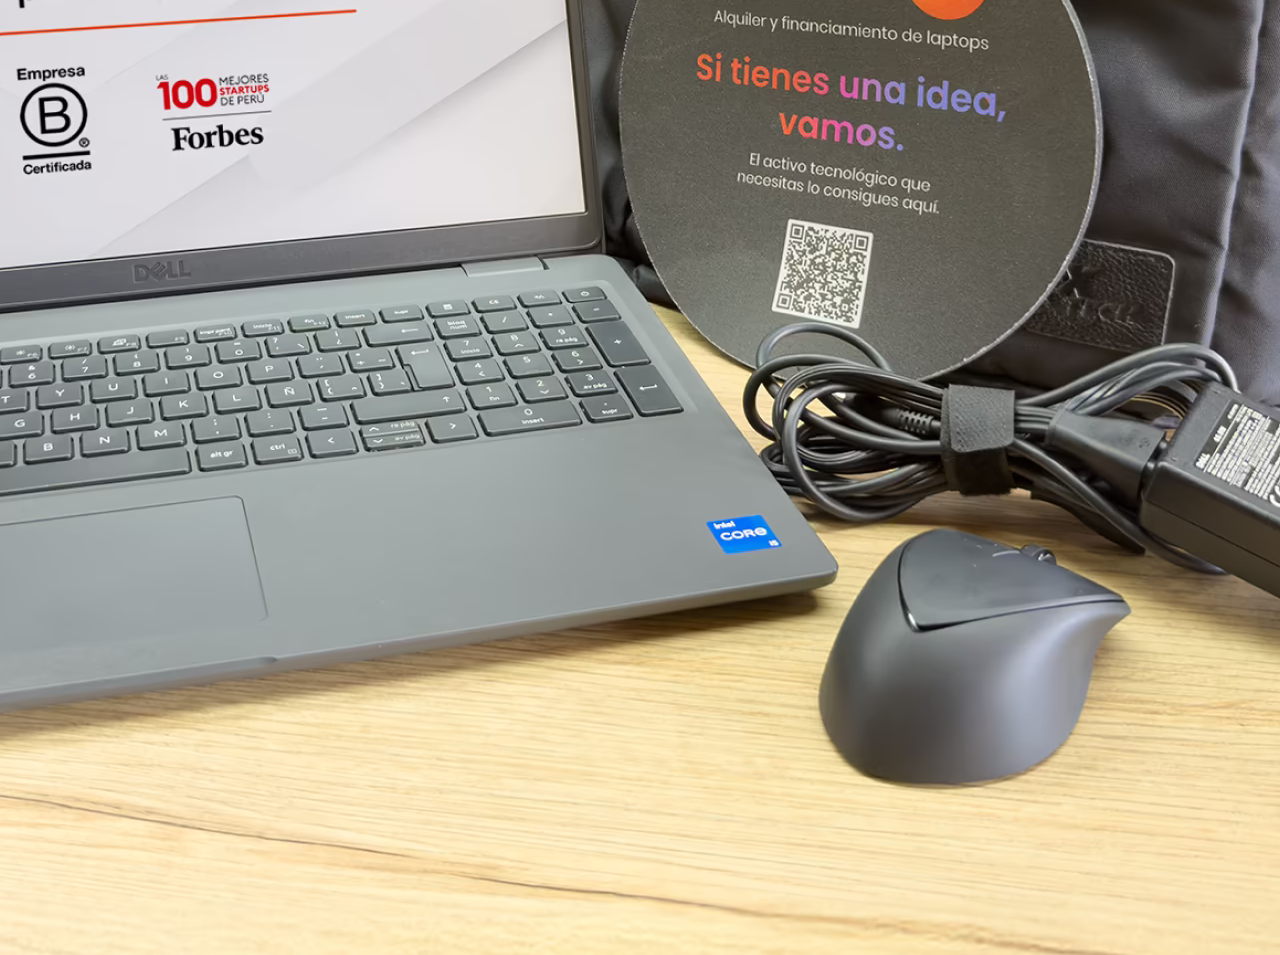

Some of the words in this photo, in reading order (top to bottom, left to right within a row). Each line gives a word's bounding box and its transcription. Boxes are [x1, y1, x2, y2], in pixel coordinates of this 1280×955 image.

[713, 9, 767, 29] Alquiler
[769, 16, 780, 32] y
[781, 15, 899, 42] financiamiento
[902, 27, 923, 44] de
[926, 28, 990, 53] laptops
[17, 67, 85, 80] Empresa
[219, 74, 269, 85] MEJORES
[157, 78, 217, 110] 100
[219, 85, 270, 95] STARTUPS
[696, 53, 723, 83] Si
[730, 58, 830, 95] tienes
[839, 76, 907, 104] una
[916, 76, 1007, 122] idea,
[221, 97, 234, 106] DE
[238, 93, 265, 105] PERÚ
[39, 96, 71, 134] B
[171, 125, 264, 151] Forbes
[778, 113, 905, 151] vamos.
[23, 160, 92, 175] Certificada
[749, 153, 761, 166] El
[763, 154, 807, 174] activo
[810, 162, 898, 190] tecnológico
[901, 177, 931, 193] que
[737, 171, 805, 193] necesitas
[807, 179, 820, 195] lo
[823, 182, 899, 209] consigues
[902, 193, 940, 215] aquí.
[133, 260, 192, 283] DELL
[235, 349, 245, 357] 0
[109, 383, 118, 391] U
[284, 387, 294, 395] Ñ
[179, 400, 188, 408] K
[15, 419, 25, 427] G
[154, 429, 167, 437] M
[100, 436, 110, 444] N
[44, 443, 53, 451] B
[720, 527, 767, 540] CORE
